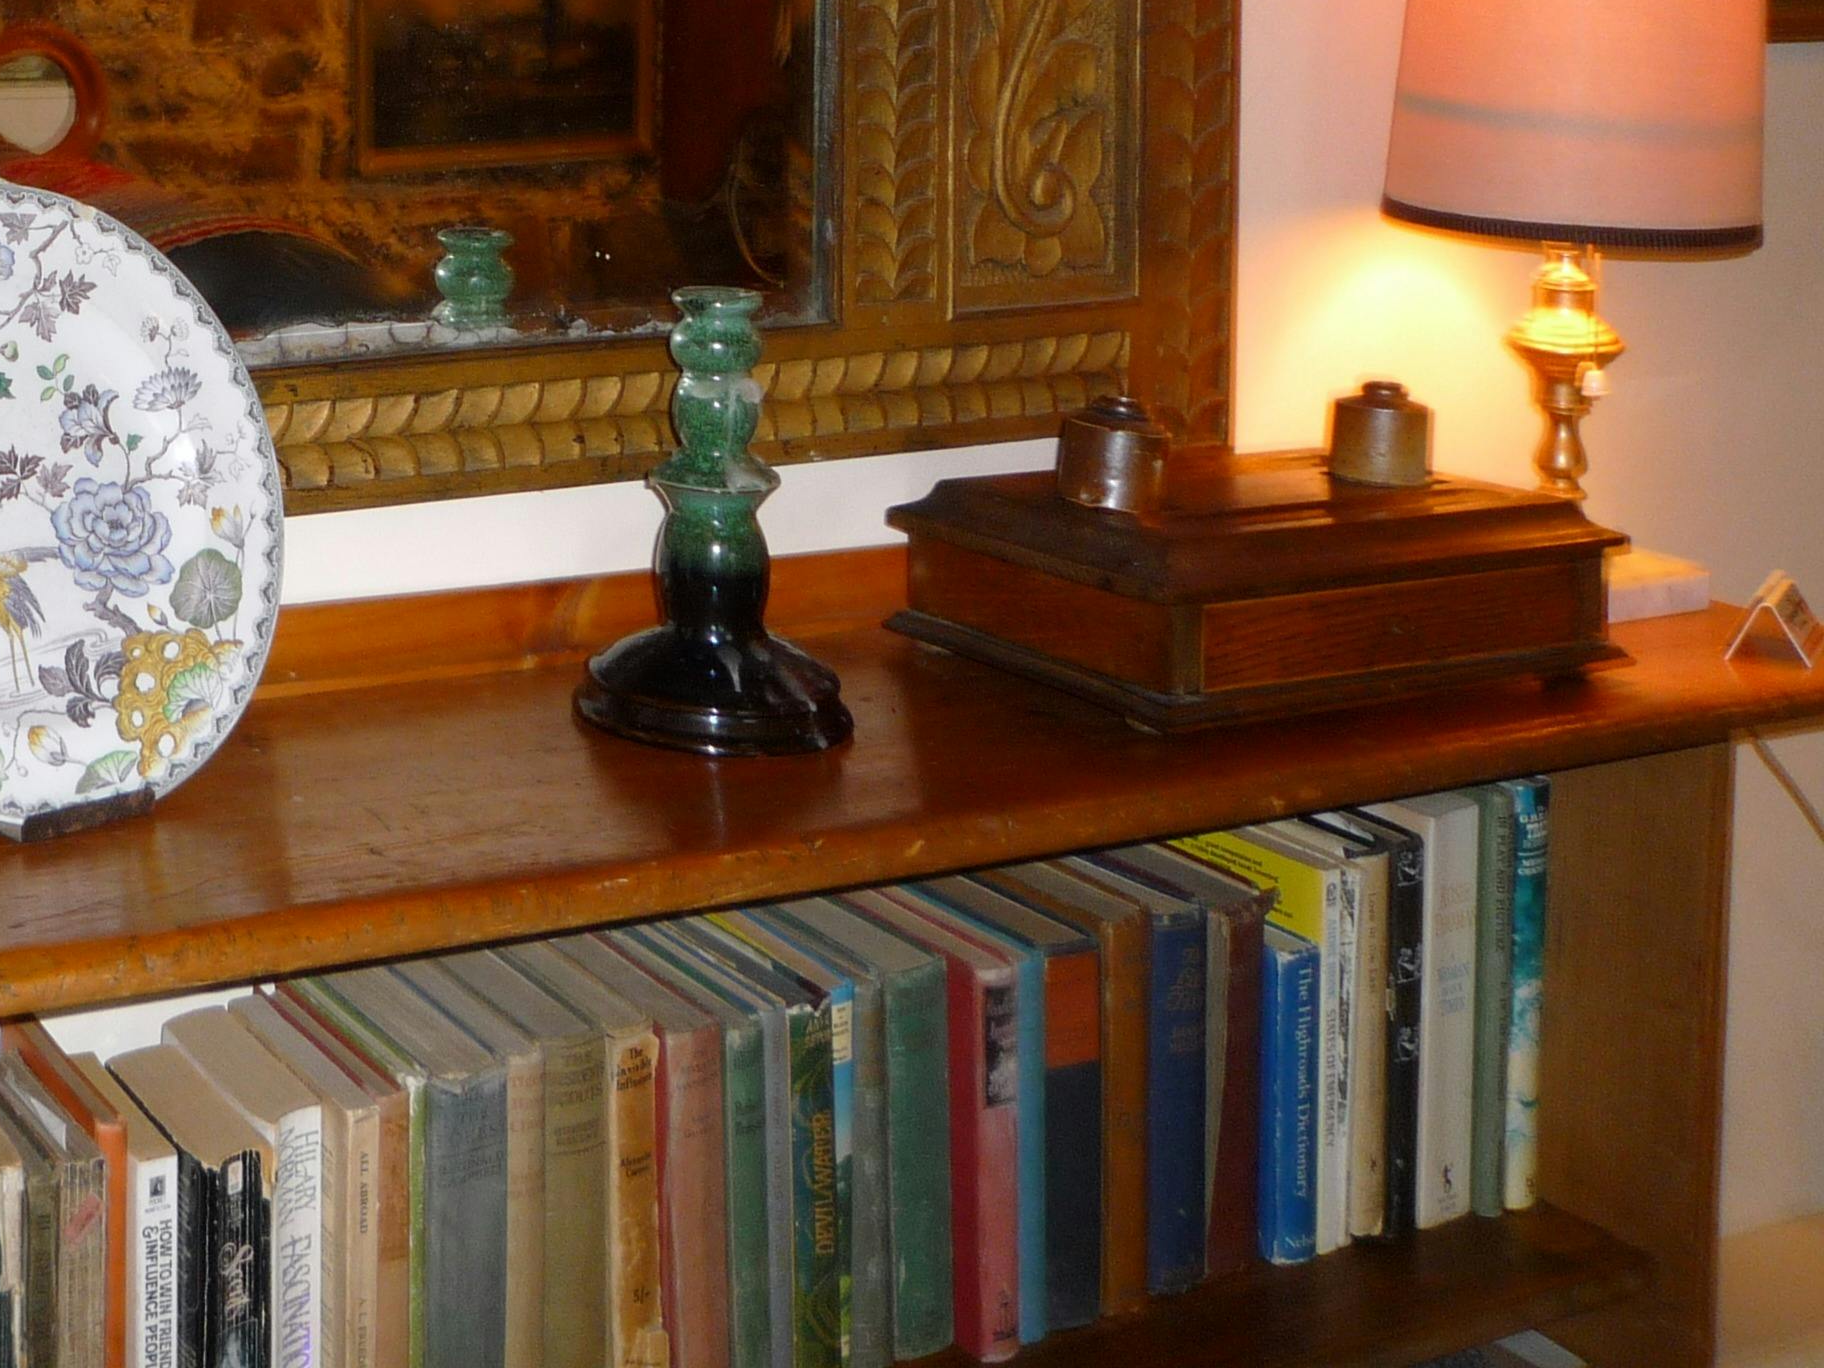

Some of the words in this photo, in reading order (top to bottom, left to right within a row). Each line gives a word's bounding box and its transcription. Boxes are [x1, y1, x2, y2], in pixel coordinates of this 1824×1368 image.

[1298, 968, 1312, 1000] The
[1295, 1006, 1312, 1100] Highroads
[280, 1127, 295, 1229] NORMAN
[293, 1130, 319, 1211] HILARY
[360, 1151, 368, 1176] ALL
[1294, 1107, 1311, 1198] Dictionary
[360, 1182, 368, 1234] ABROAD
[160, 1219, 173, 1259] HOW
[144, 1240, 159, 1321] INFLUENCE
[160, 1261, 173, 1281] TO
[160, 1283, 172, 1315] WIN
